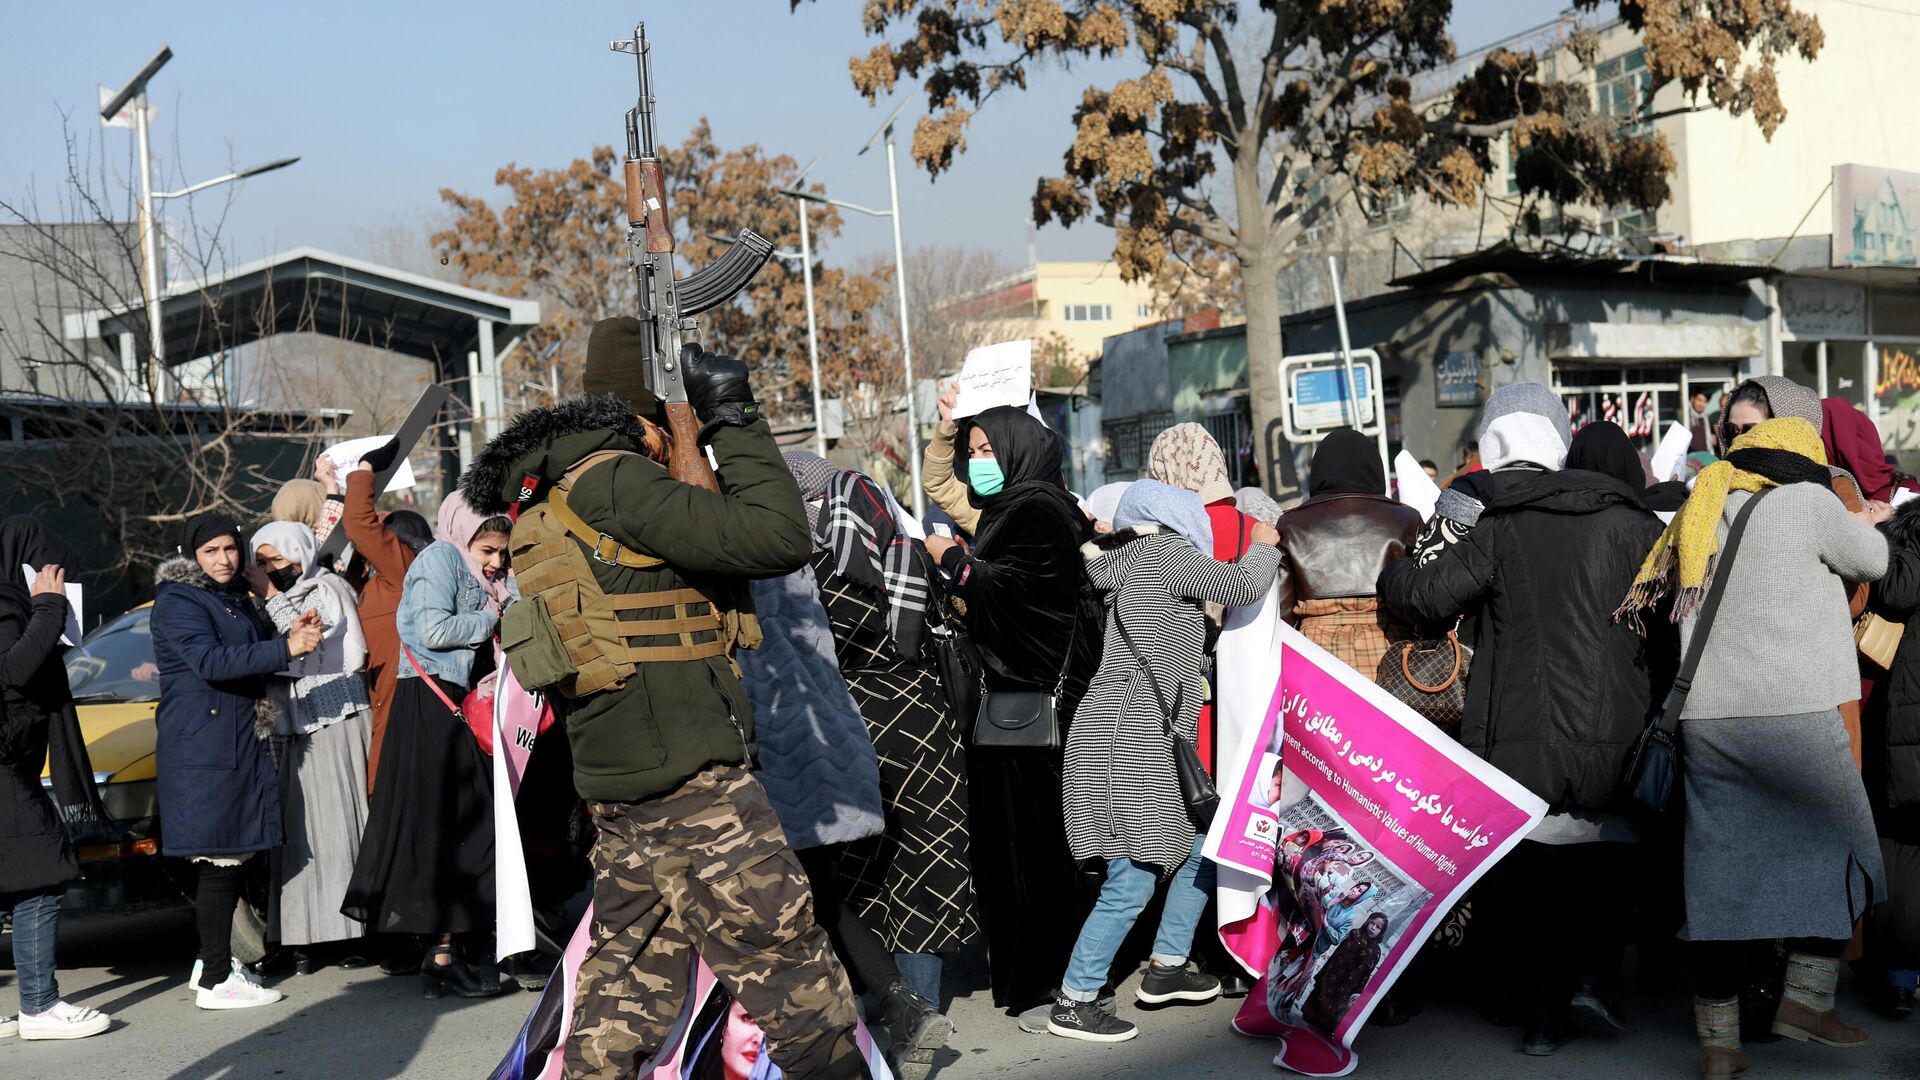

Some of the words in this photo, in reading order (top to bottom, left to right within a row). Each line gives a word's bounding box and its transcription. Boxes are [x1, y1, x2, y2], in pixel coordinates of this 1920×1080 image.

[1297, 697, 1308, 723] با
[1305, 711, 1342, 744] مطابق
[1337, 740, 1352, 757] و
[1301, 746, 1333, 781] according
[1333, 772, 1342, 786] to
[1341, 778, 1384, 819] Humanistic
[1395, 778, 1442, 815] حکومت
[1381, 810, 1410, 839] Values
[1440, 804, 1454, 826] ما
[1407, 833, 1420, 845] of
[1451, 818, 1493, 850] خواست
[1412, 836, 1437, 862] Human
